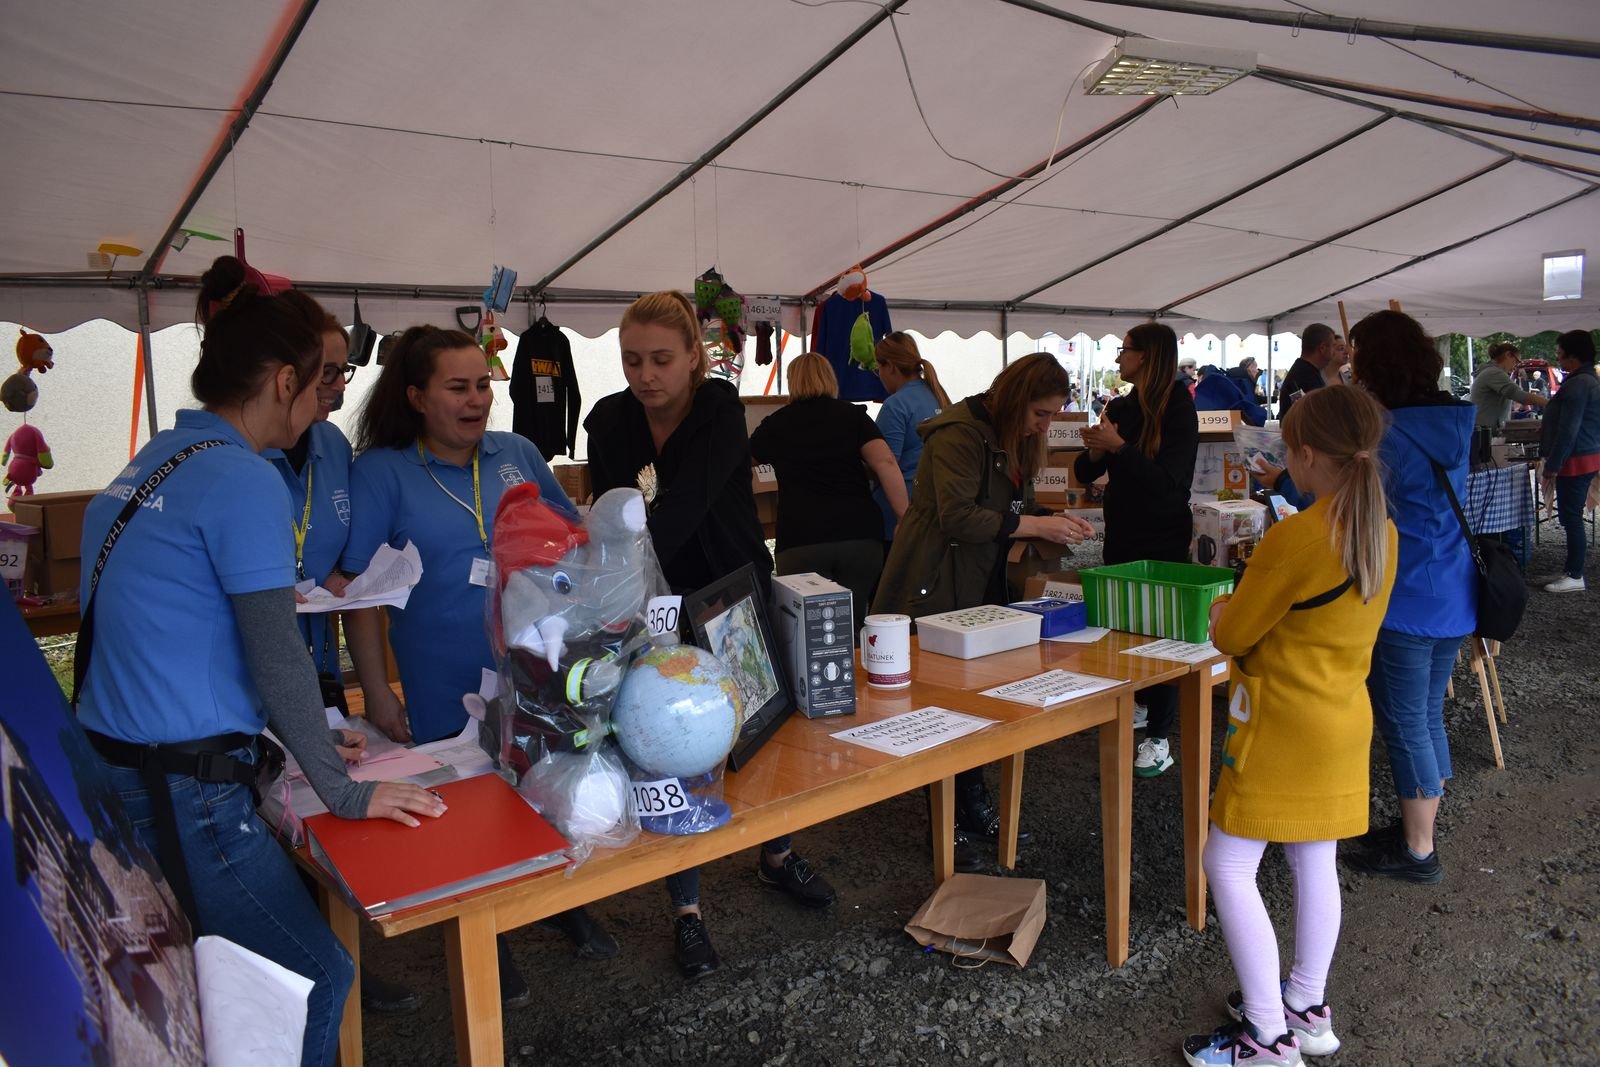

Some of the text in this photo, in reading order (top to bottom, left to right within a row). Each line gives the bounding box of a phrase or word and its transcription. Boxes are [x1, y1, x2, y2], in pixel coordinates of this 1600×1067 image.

[134, 461, 175, 507] RIGHT
[96, 519, 126, 572] THAT'S
[633, 783, 685, 813] 1038
